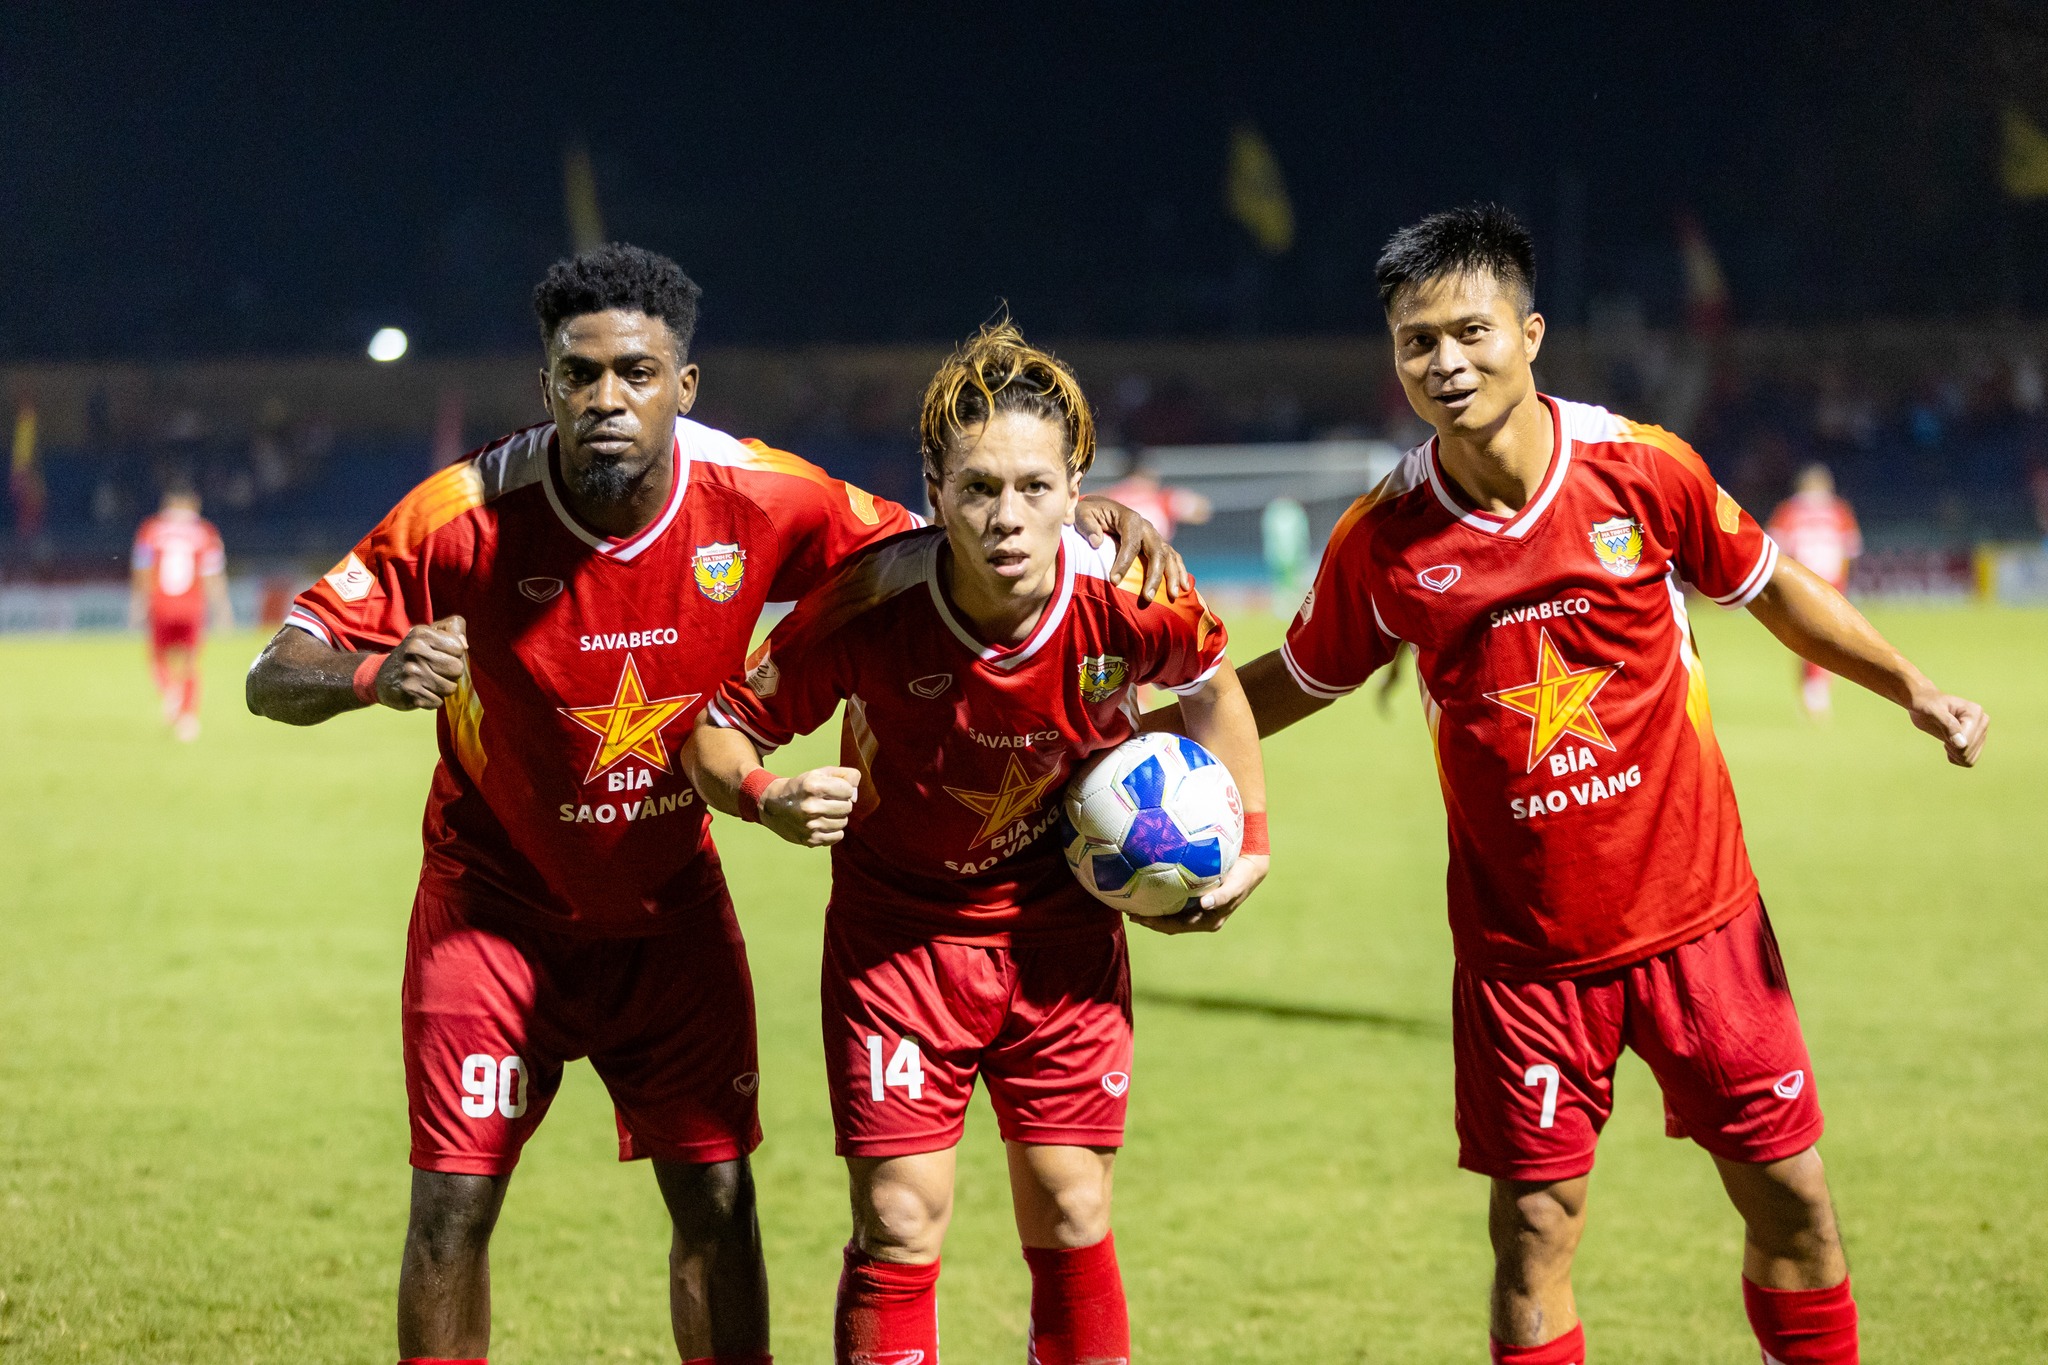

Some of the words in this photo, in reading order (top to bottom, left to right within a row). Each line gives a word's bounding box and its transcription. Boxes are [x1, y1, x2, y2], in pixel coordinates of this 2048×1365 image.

[1490, 597, 1591, 629] SAVABECO
[579, 627, 679, 652] SAVABECO
[967, 727, 1061, 749] SAVABECO
[559, 803, 617, 823] SAO
[621, 788, 695, 822] VÀNG
[1510, 789, 1569, 820] SAO
[1571, 764, 1642, 807] VÀNG
[945, 855, 1000, 875] SAO
[866, 1034, 926, 1102] 14
[460, 1053, 529, 1120] 90
[1523, 1063, 1560, 1129] 7
